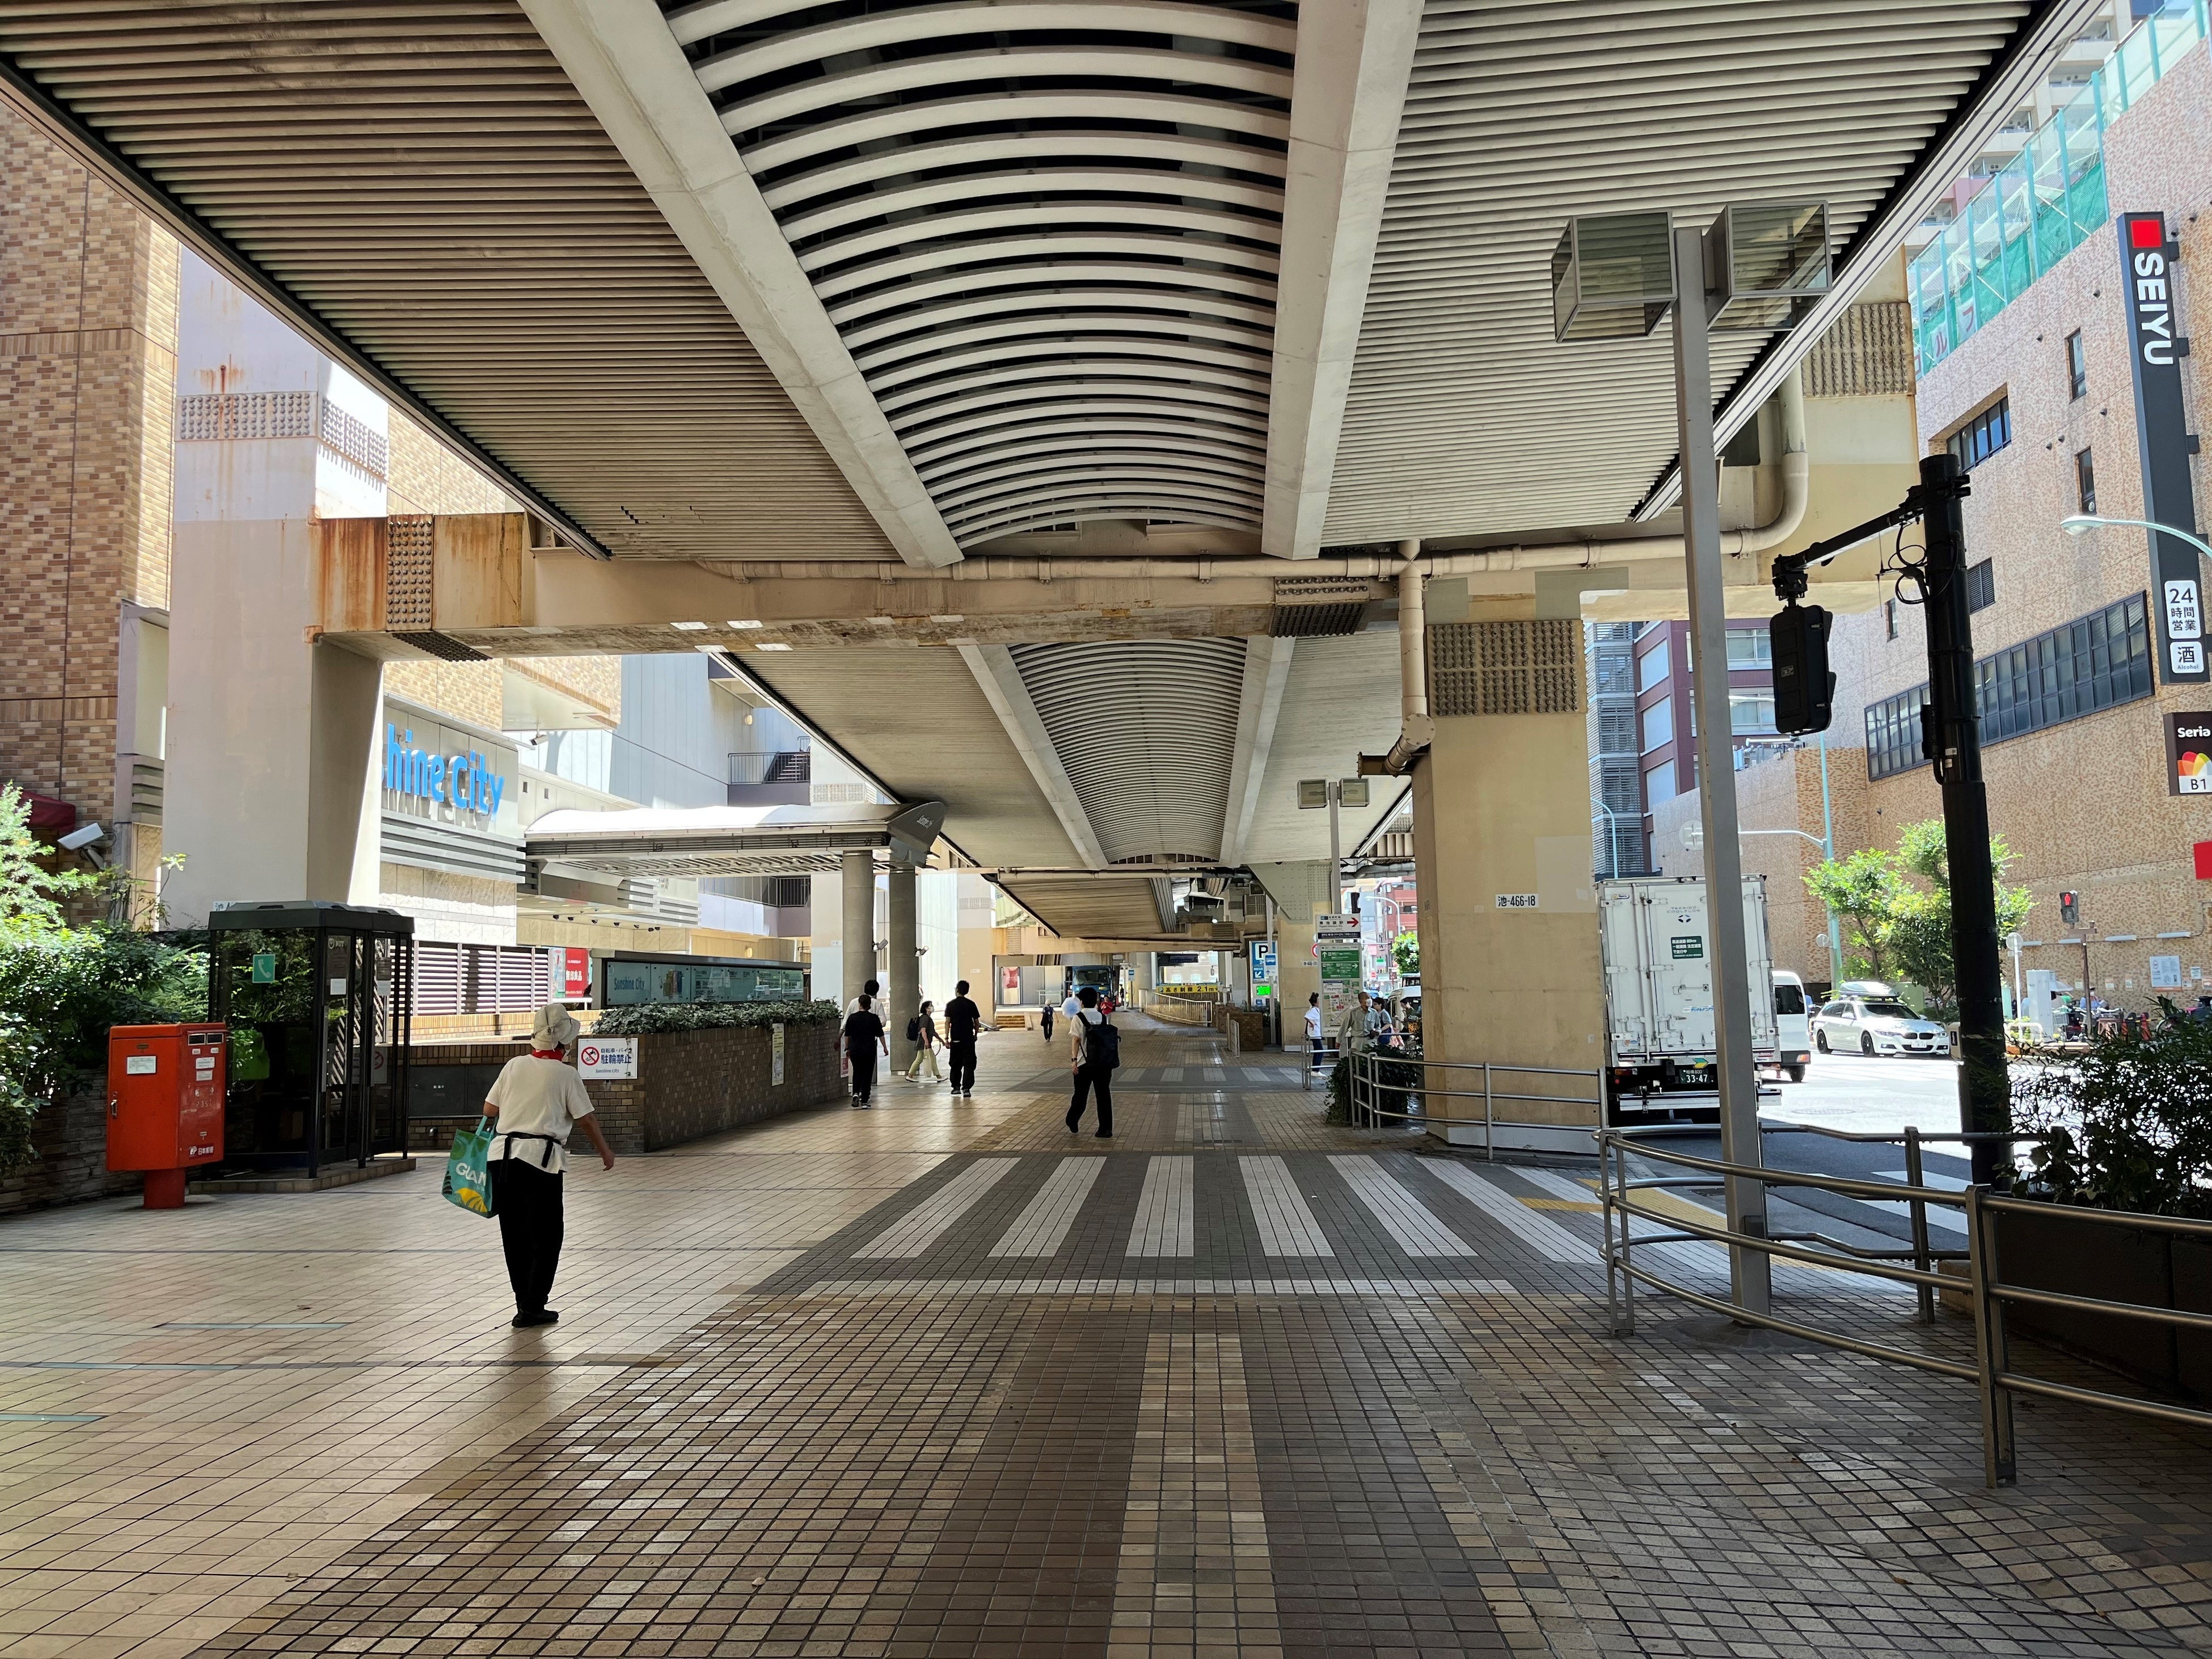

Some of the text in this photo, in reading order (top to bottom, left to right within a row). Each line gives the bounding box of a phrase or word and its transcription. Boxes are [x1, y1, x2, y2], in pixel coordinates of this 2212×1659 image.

[2134, 252, 2173, 365] SEIYU
[2169, 588, 2194, 603] 24
[2171, 607, 2194, 618] 時間
[2172, 620, 2196, 631] 営業
[2177, 646, 2195, 663] 酒
[2177, 725, 2211, 738] Seria
[382, 723, 504, 821] hine City
[2190, 778, 2206, 790] B1
[1498, 895, 1535, 906] 池-466-18
[1259, 945, 1268, 958] P
[614, 976, 645, 991] Sunshine City
[601, 1054, 632, 1065] 駐輪禁止
[1686, 1074, 1708, 1083] 33-47
